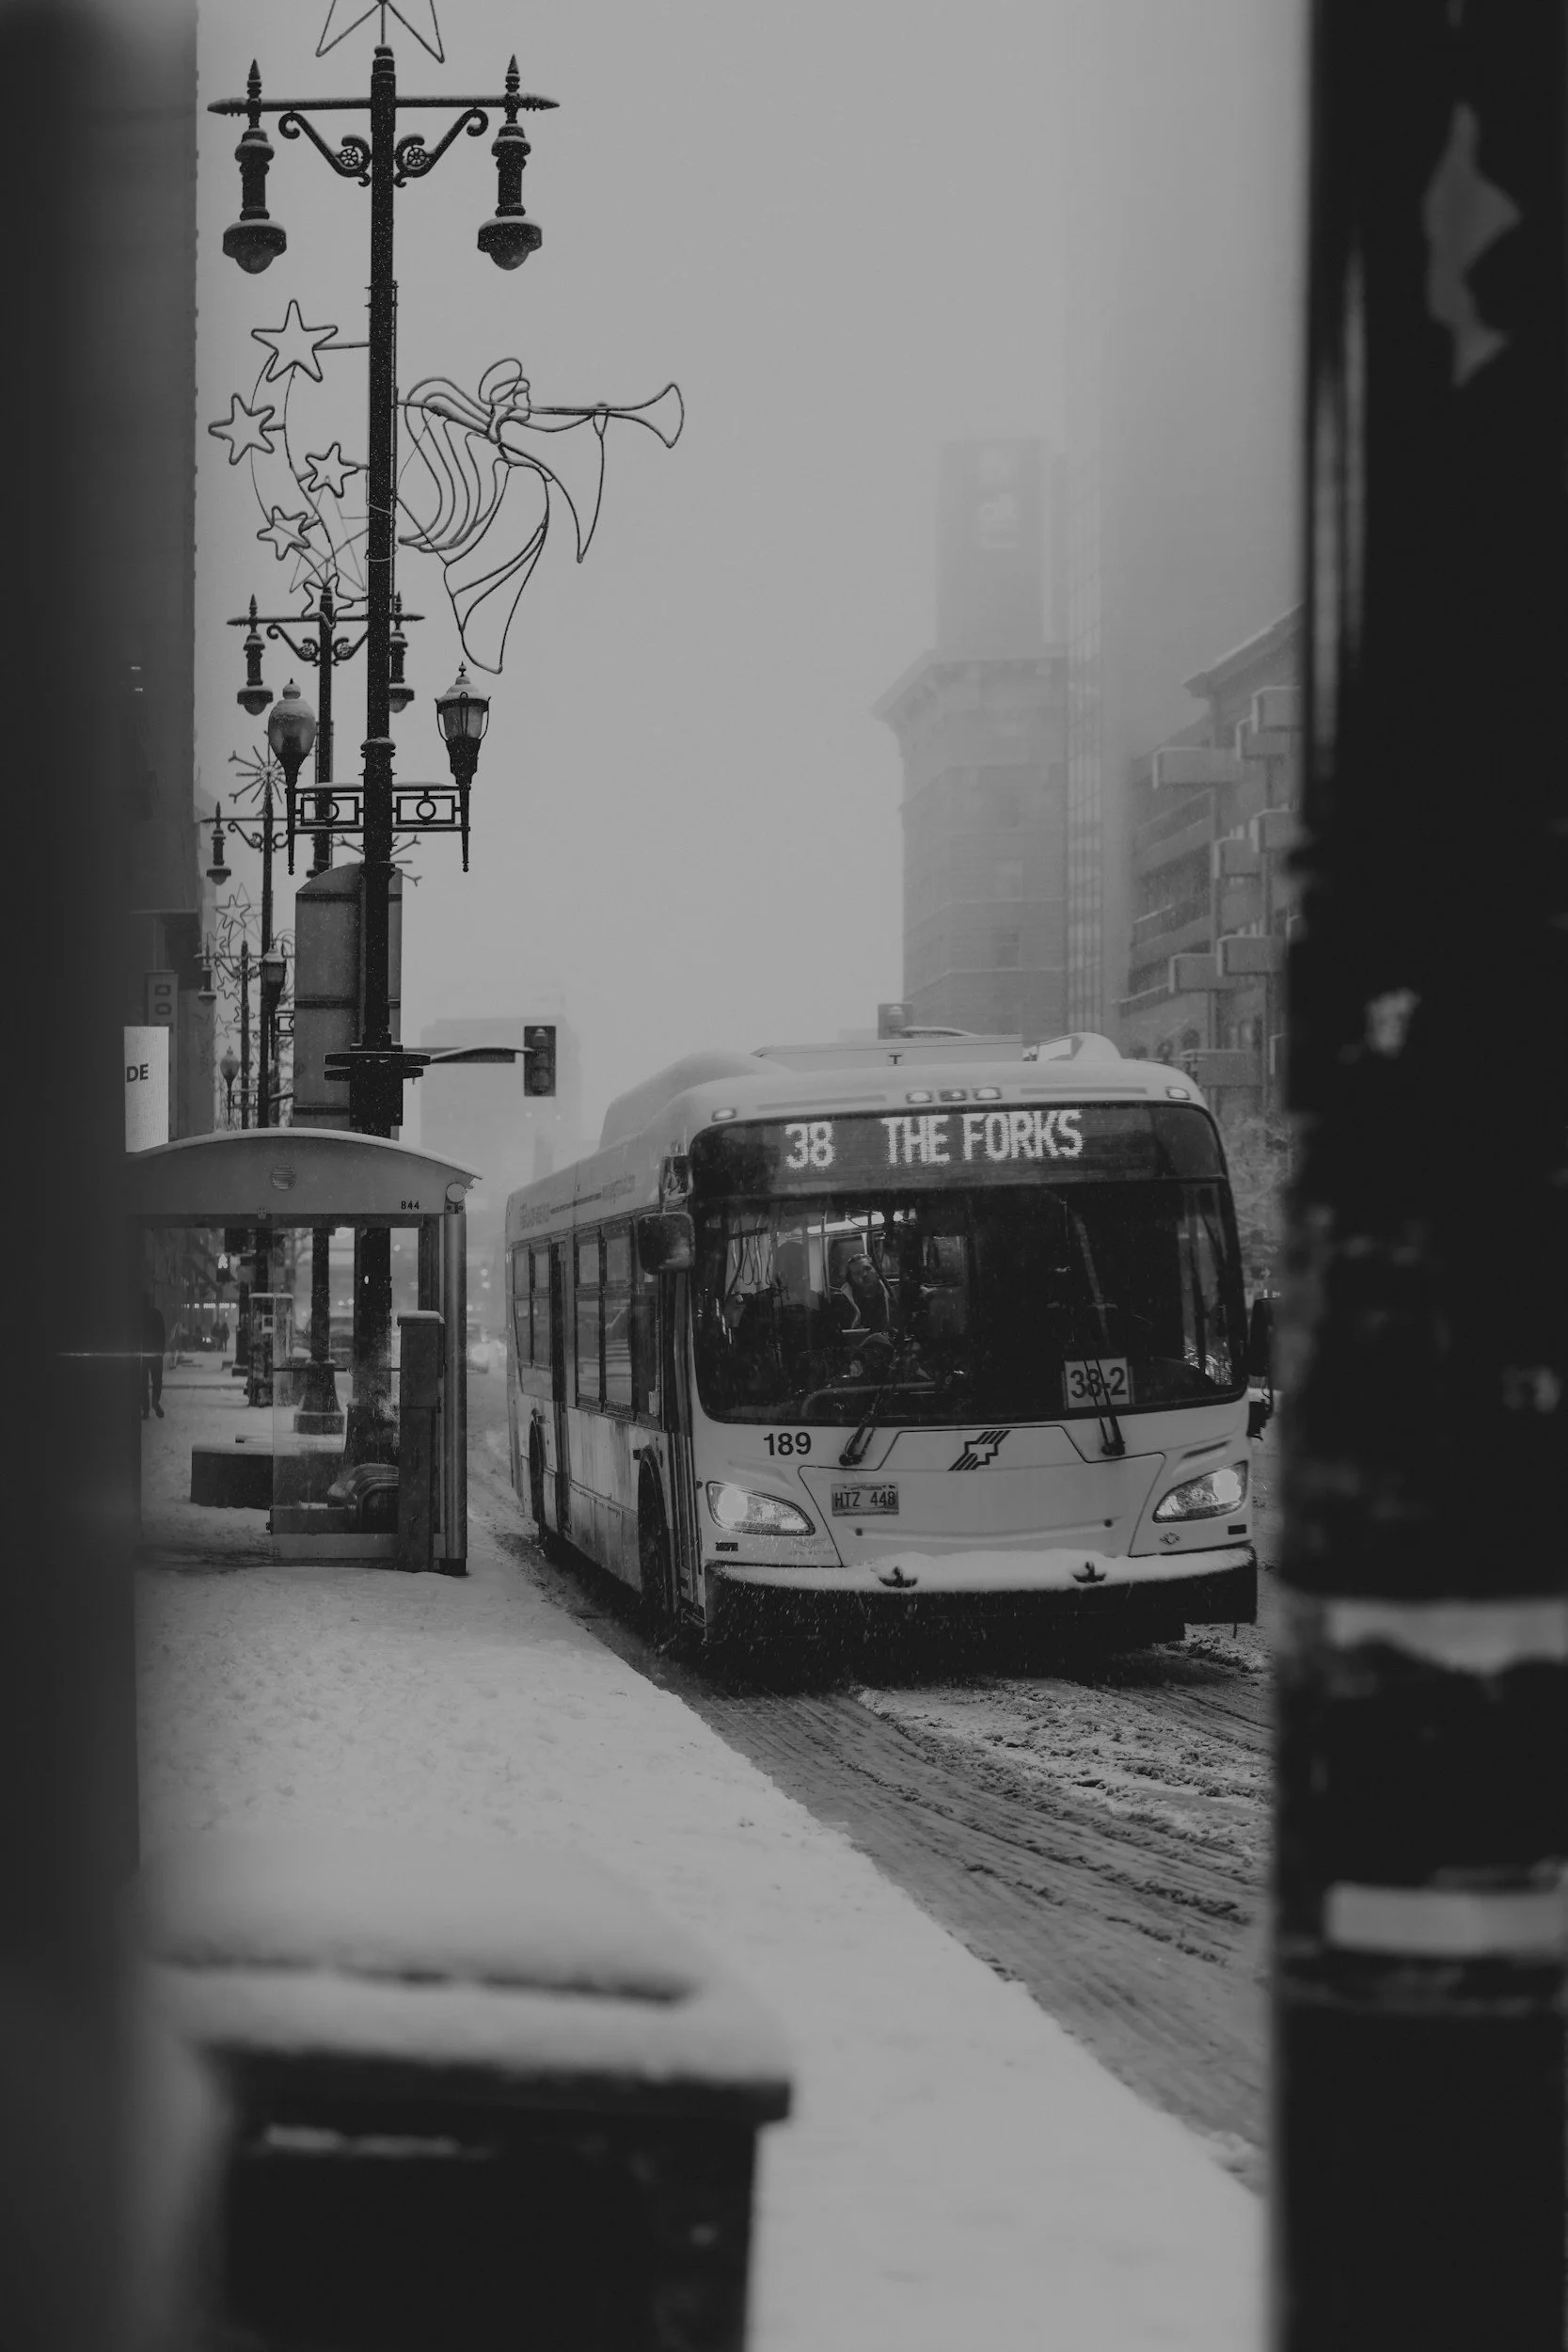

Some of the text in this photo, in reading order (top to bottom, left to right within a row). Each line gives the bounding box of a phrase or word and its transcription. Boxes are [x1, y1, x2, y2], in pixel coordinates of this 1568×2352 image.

[784, 1110, 1084, 1169] 38 THE FORKS
[401, 1200, 420, 1210] 844
[1070, 1367, 1127, 1398] 38-2
[764, 1432, 811, 1455] 189
[835, 1491, 895, 1507] HTZ 448
